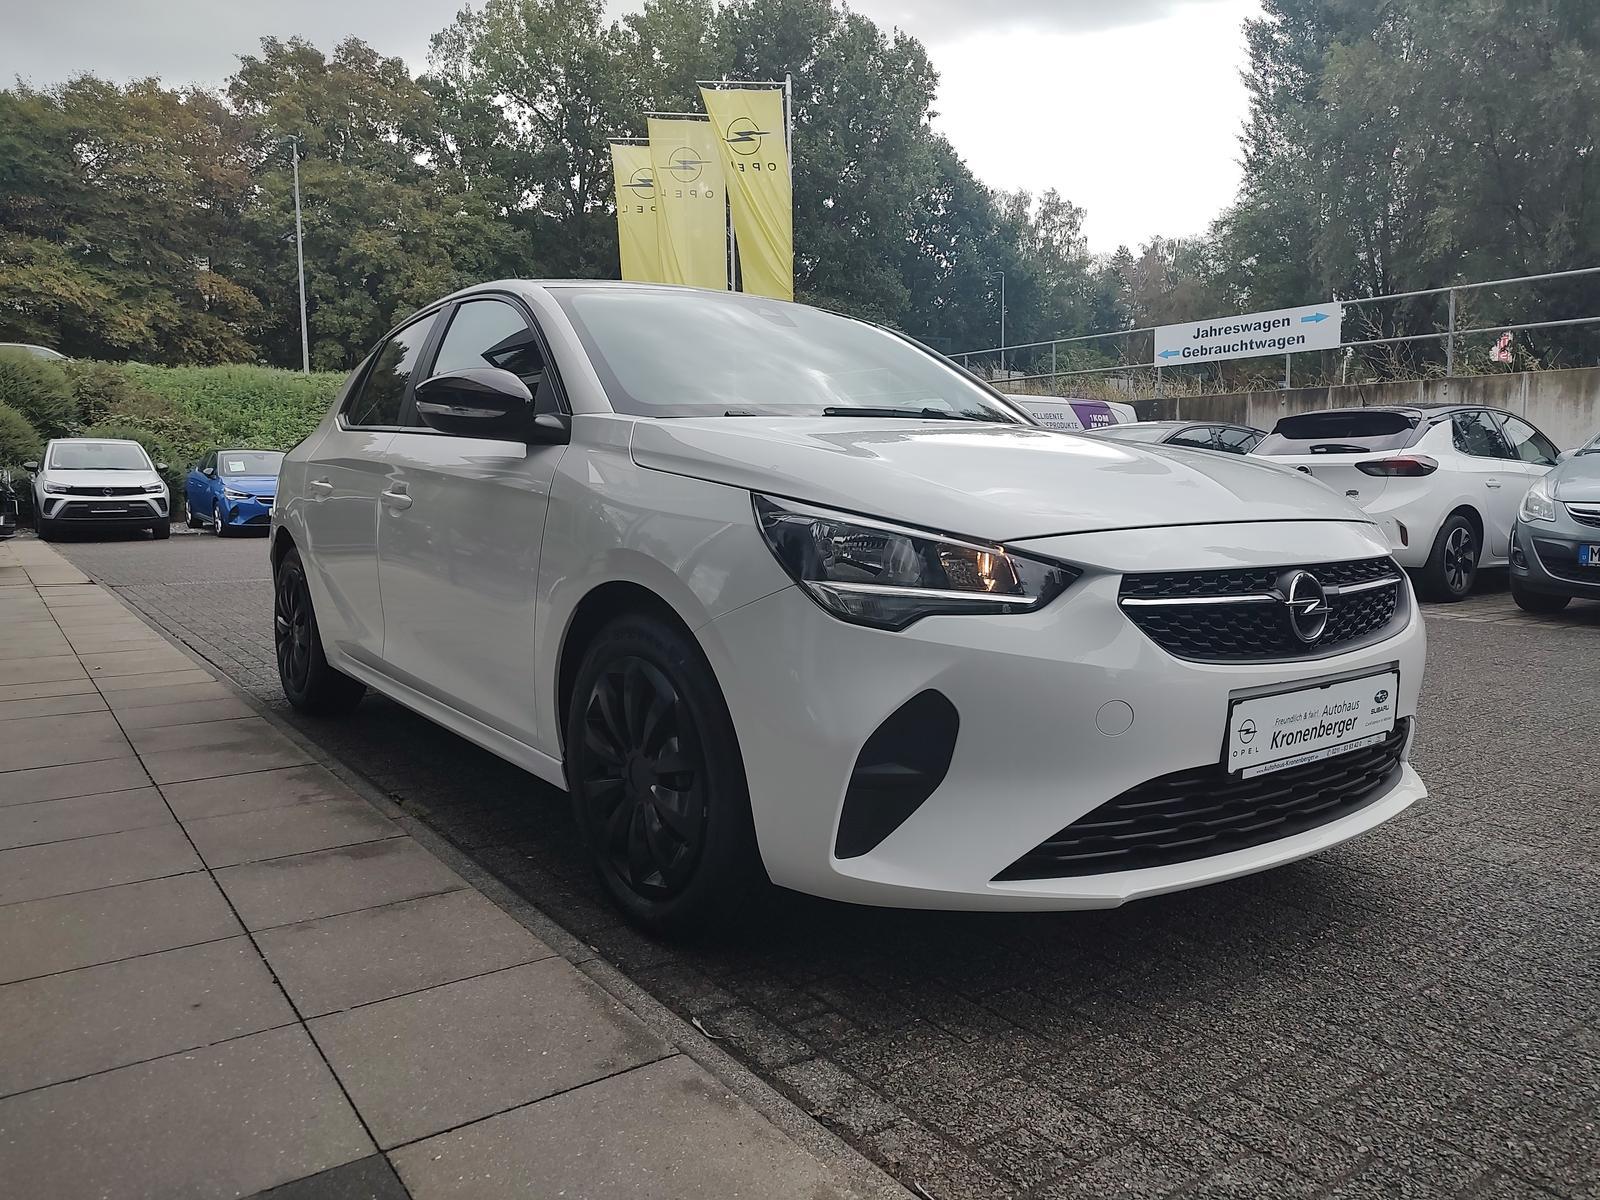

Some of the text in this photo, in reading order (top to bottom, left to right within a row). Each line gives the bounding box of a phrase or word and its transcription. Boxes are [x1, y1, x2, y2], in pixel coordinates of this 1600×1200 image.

[1193, 317, 1290, 340] Jahreswagen
[1182, 334, 1305, 358] Gebrauchtwagen
[1032, 412, 1064, 420] ELLIGENTE
[1321, 699, 1360, 718] Autohaus
[1370, 704, 1390, 715] SUBARU
[1270, 717, 1358, 750] Kronenberger
[1233, 747, 1259, 757] OPEL
